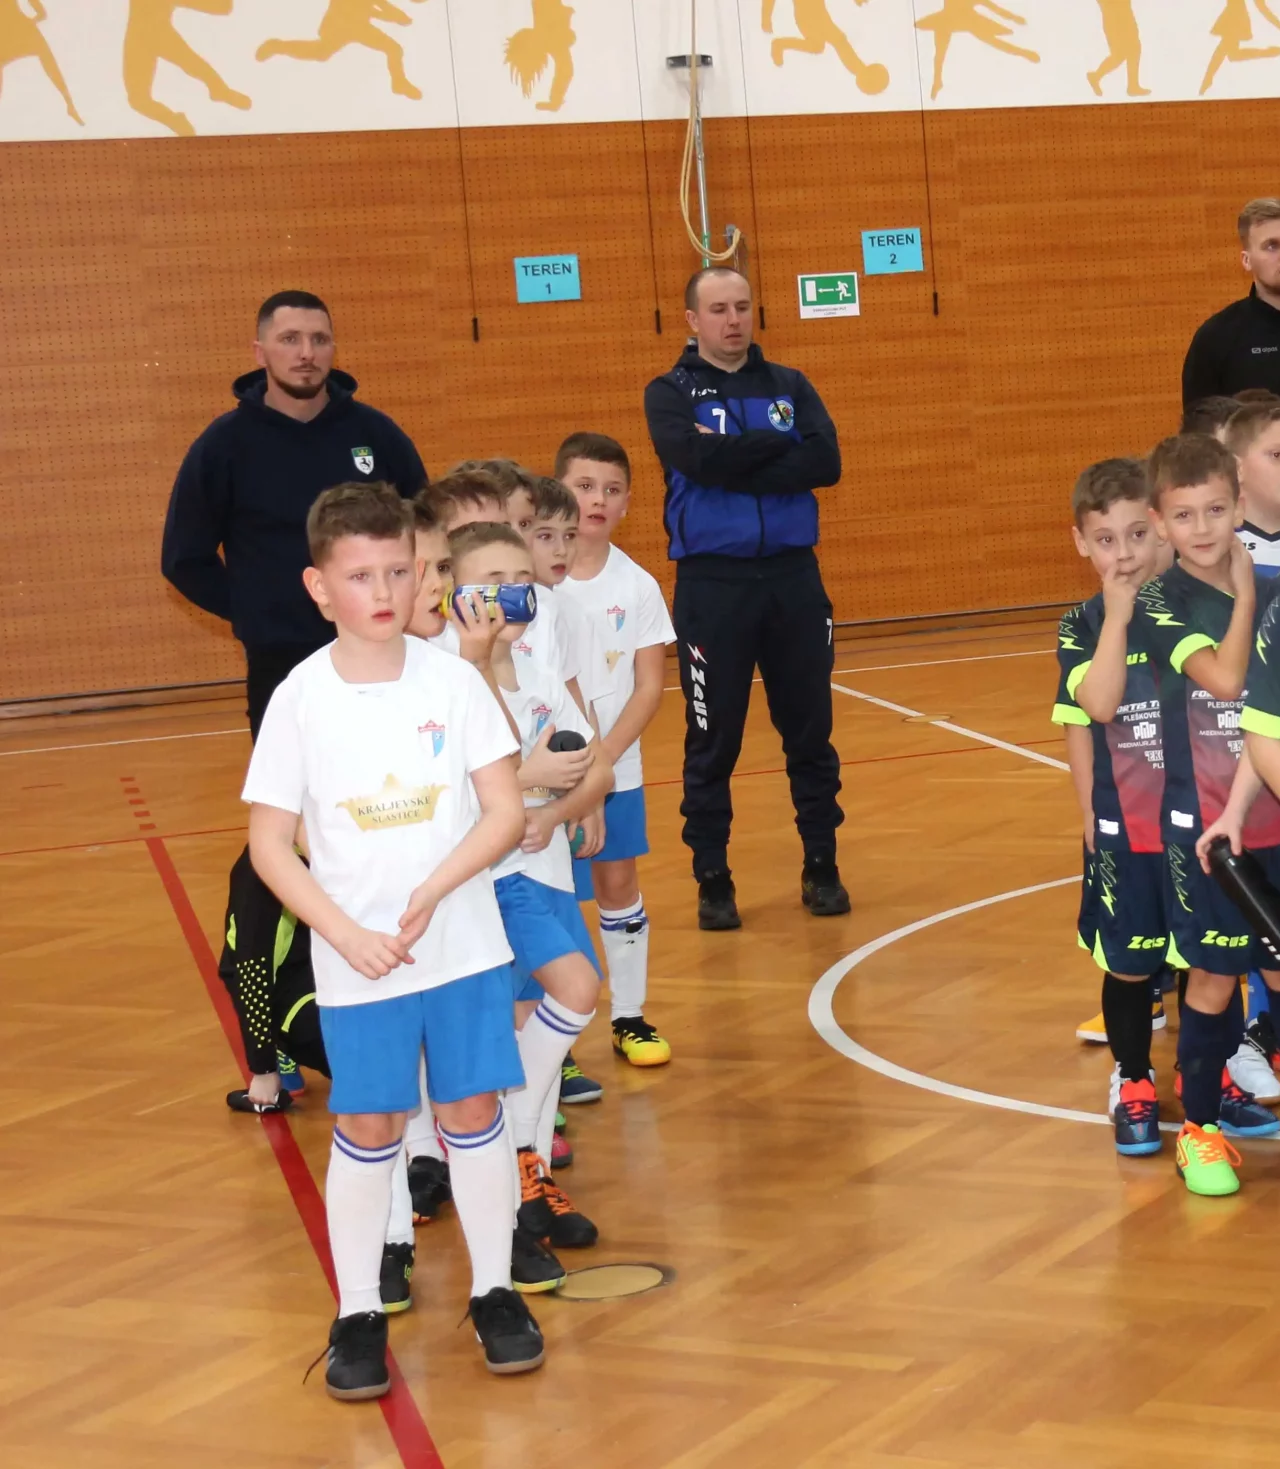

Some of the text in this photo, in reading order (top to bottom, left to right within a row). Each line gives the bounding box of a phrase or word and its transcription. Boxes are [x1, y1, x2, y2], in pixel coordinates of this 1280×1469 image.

[868, 233, 915, 248] TEREN
[889, 253, 898, 266] 2
[522, 263, 572, 277] TEREN
[545, 283, 553, 295] 1
[711, 407, 727, 435] 7
[1126, 651, 1148, 666] us
[689, 663, 708, 731] Zeus
[357, 795, 431, 817] KRALJEVSKE
[371, 808, 421, 825] SLASTICE
[1200, 929, 1249, 948] Zeus
